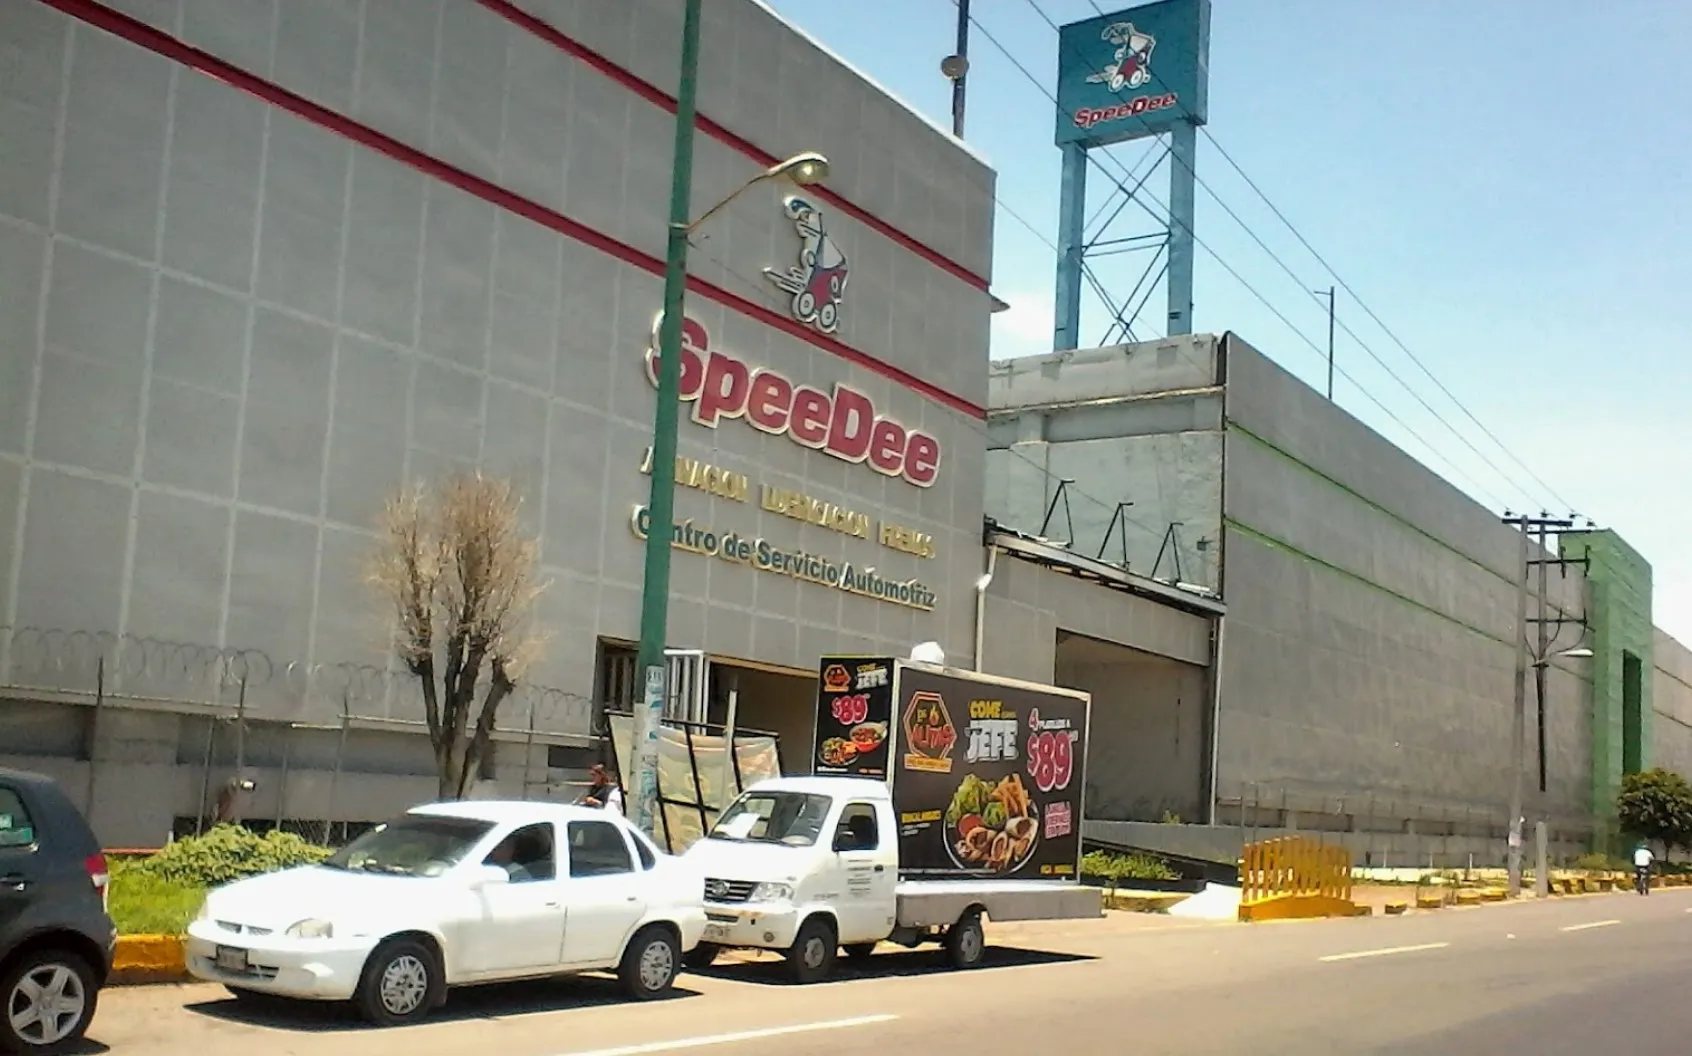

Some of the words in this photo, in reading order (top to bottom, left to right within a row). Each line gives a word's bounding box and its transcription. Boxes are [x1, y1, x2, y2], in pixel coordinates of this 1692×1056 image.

[1074, 93, 1177, 128] SpeeDee
[645, 310, 940, 487] SpeeDee
[631, 504, 718, 555] Cntro
[722, 530, 753, 562] de
[754, 538, 838, 588] Servicio
[839, 562, 937, 611] Automotriz
[969, 699, 1002, 718] COME
[964, 719, 1019, 763] JEFE
